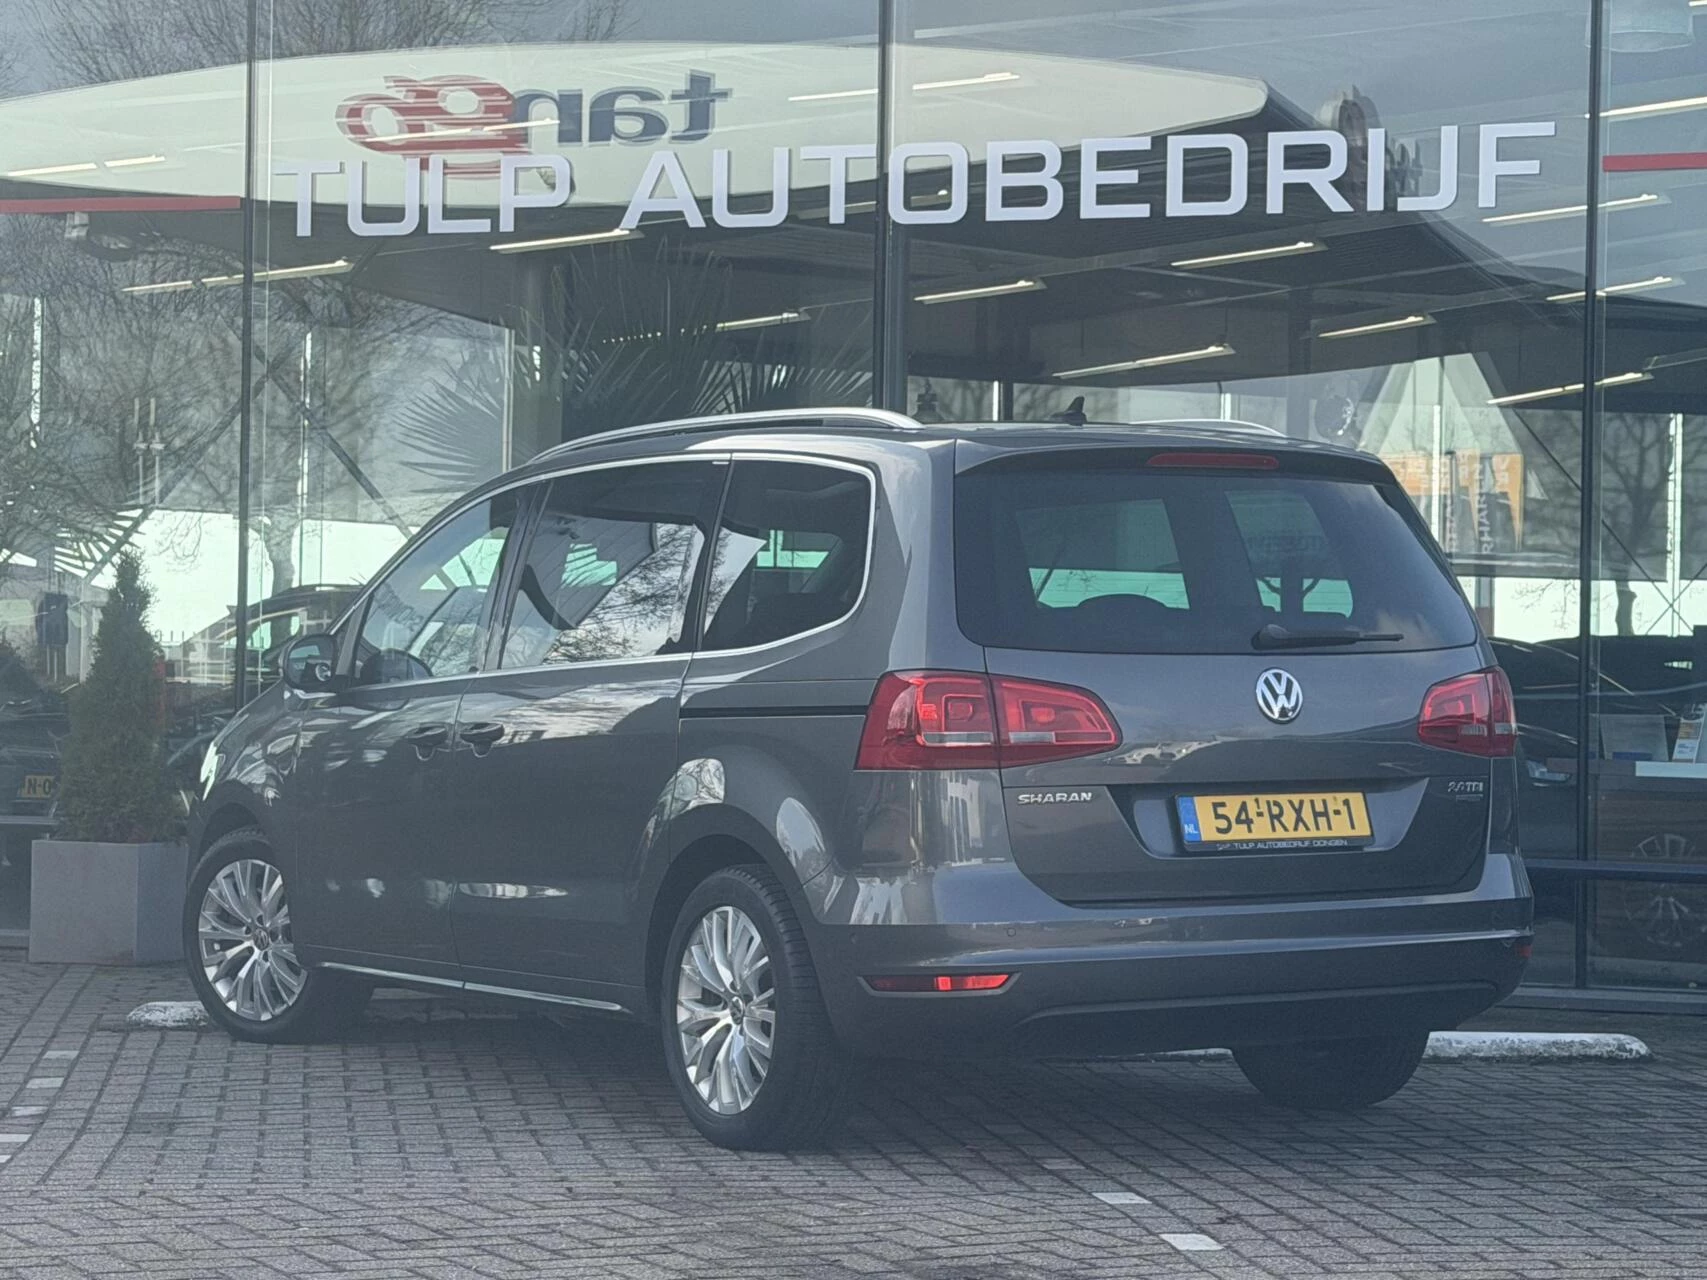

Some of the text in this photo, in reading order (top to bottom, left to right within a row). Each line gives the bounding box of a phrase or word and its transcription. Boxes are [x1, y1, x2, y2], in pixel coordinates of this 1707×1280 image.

[274, 121, 1556, 237] TULP AUTOBEDRIJF
[1017, 792, 1092, 805] SHARAN
[1184, 823, 1198, 834] NL
[1234, 842, 1254, 850] TULP
[1312, 839, 1348, 848] DONGEN
